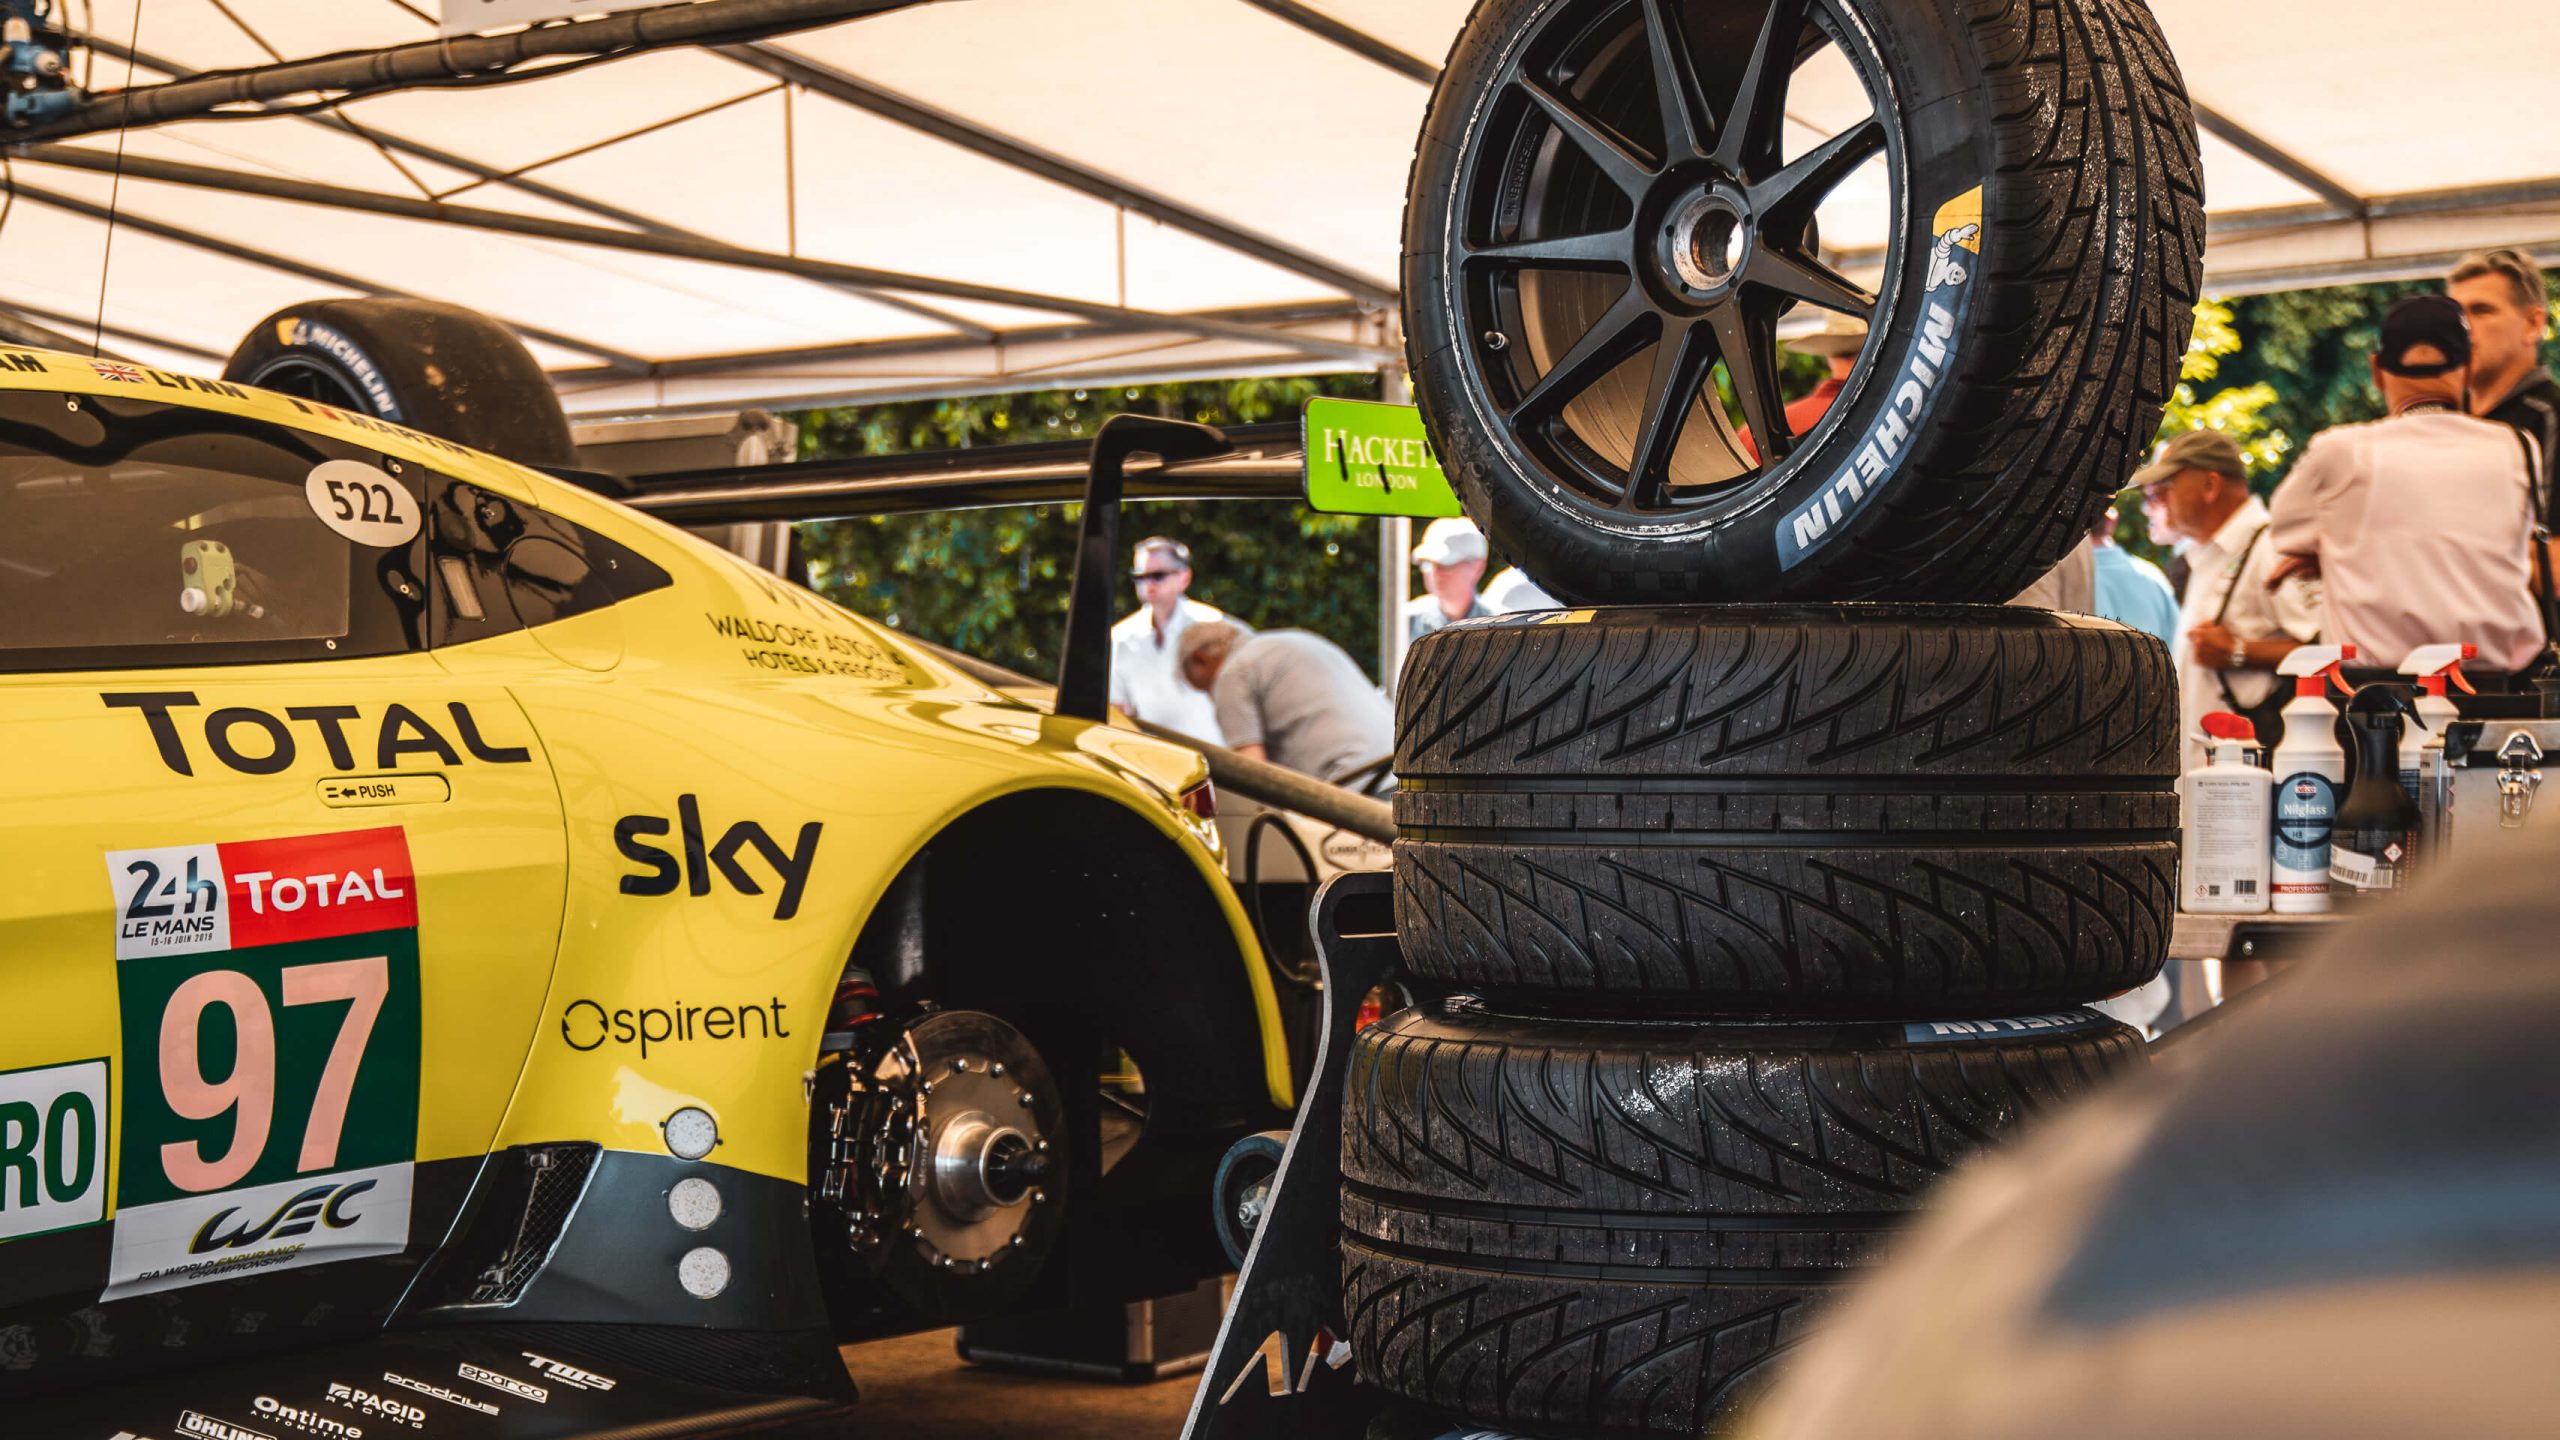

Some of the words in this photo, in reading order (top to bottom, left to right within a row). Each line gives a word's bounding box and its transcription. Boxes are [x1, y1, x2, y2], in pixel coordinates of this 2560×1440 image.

[146, 369, 249, 400] LYNN
[310, 325, 395, 413] MICHELIN
[1793, 302, 1955, 550] MICHELIN
[1324, 429, 1441, 470] HACKET
[1356, 472, 1418, 490] LONDON
[325, 480, 404, 525] 522
[705, 612, 819, 650] WALDORF
[742, 648, 818, 674] HOTELS
[818, 658, 834, 676] &
[98, 691, 532, 777] TOTAL
[358, 784, 397, 799] PUSH
[2283, 804, 2327, 817] Nilglass
[614, 793, 824, 921] sky
[125, 856, 218, 919] 24h
[234, 868, 404, 915] TOTAL
[121, 922, 149, 939] LE
[152, 916, 215, 936] MANS
[151, 936, 173, 946] 15-16
[174, 935, 192, 944] JUIN
[614, 996, 790, 1060] spirent
[158, 955, 390, 1193] 97
[188, 1178, 379, 1255] WEC
[137, 1271, 161, 1281] FIA
[165, 1259, 216, 1279] WORLD
[214, 1243, 306, 1267] ENDURANCE
[189, 1254, 295, 1280] CHAMPIONSHIP
[460, 1364, 546, 1400] sparco
[522, 1352, 616, 1391] TWS
[253, 1396, 363, 1439] Ontime
[325, 1395, 423, 1429] RACING
[352, 1389, 426, 1422] PAGID
